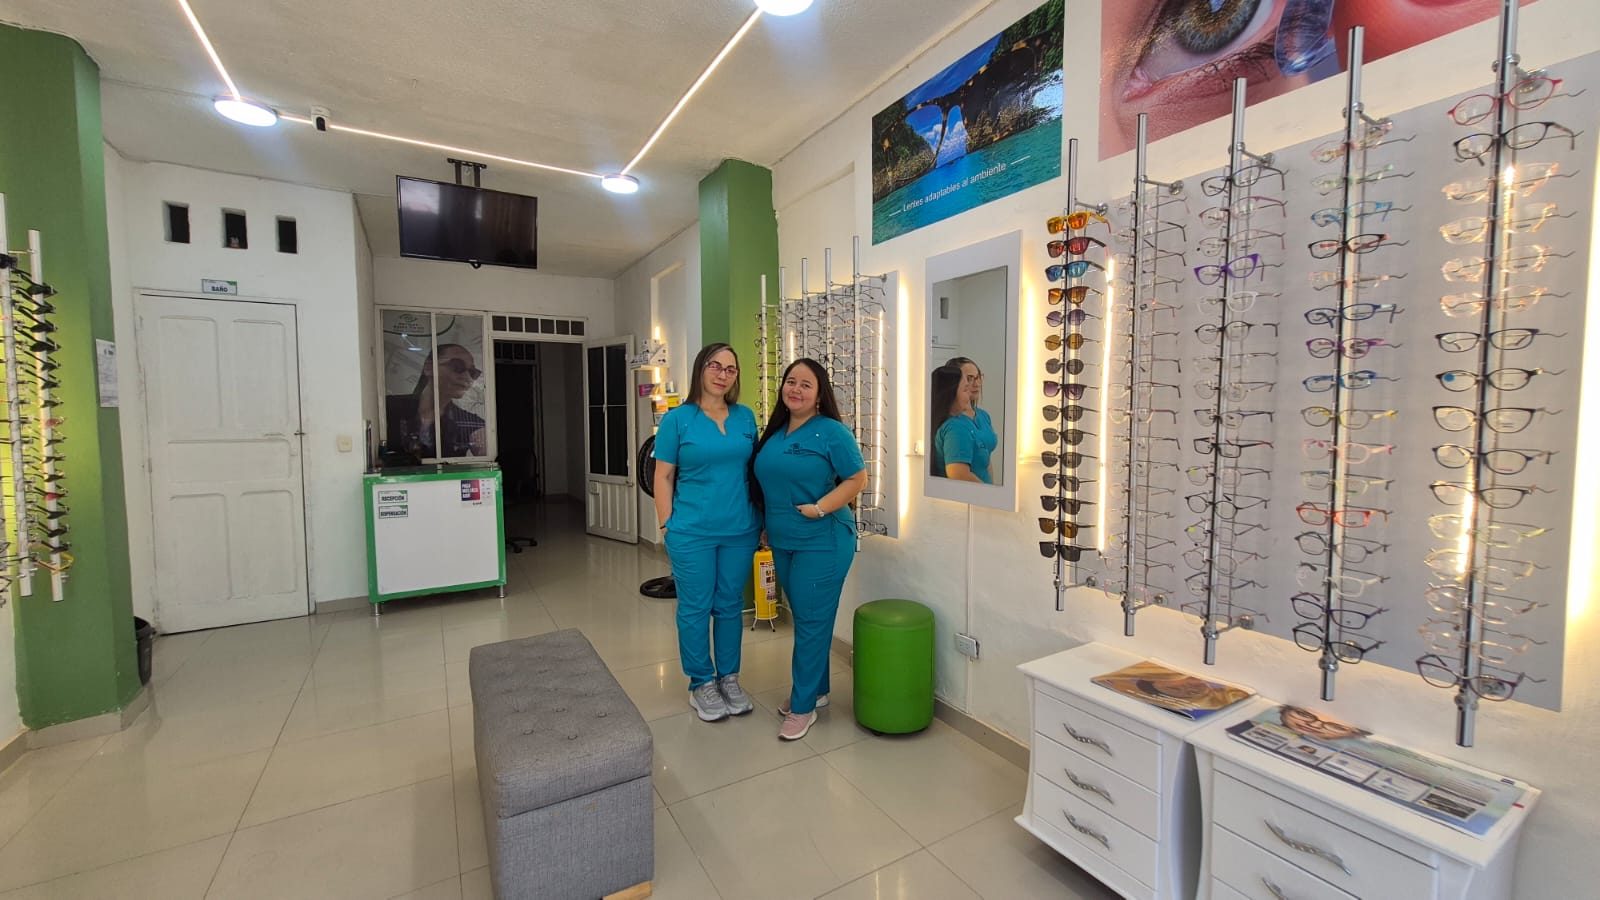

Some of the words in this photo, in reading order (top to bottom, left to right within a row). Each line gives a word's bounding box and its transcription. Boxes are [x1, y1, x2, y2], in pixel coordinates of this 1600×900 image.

[903, 198, 924, 212] Lentes
[924, 182, 961, 203] adaptables
[961, 178, 969, 188] al
[970, 163, 1007, 184] ambiente
